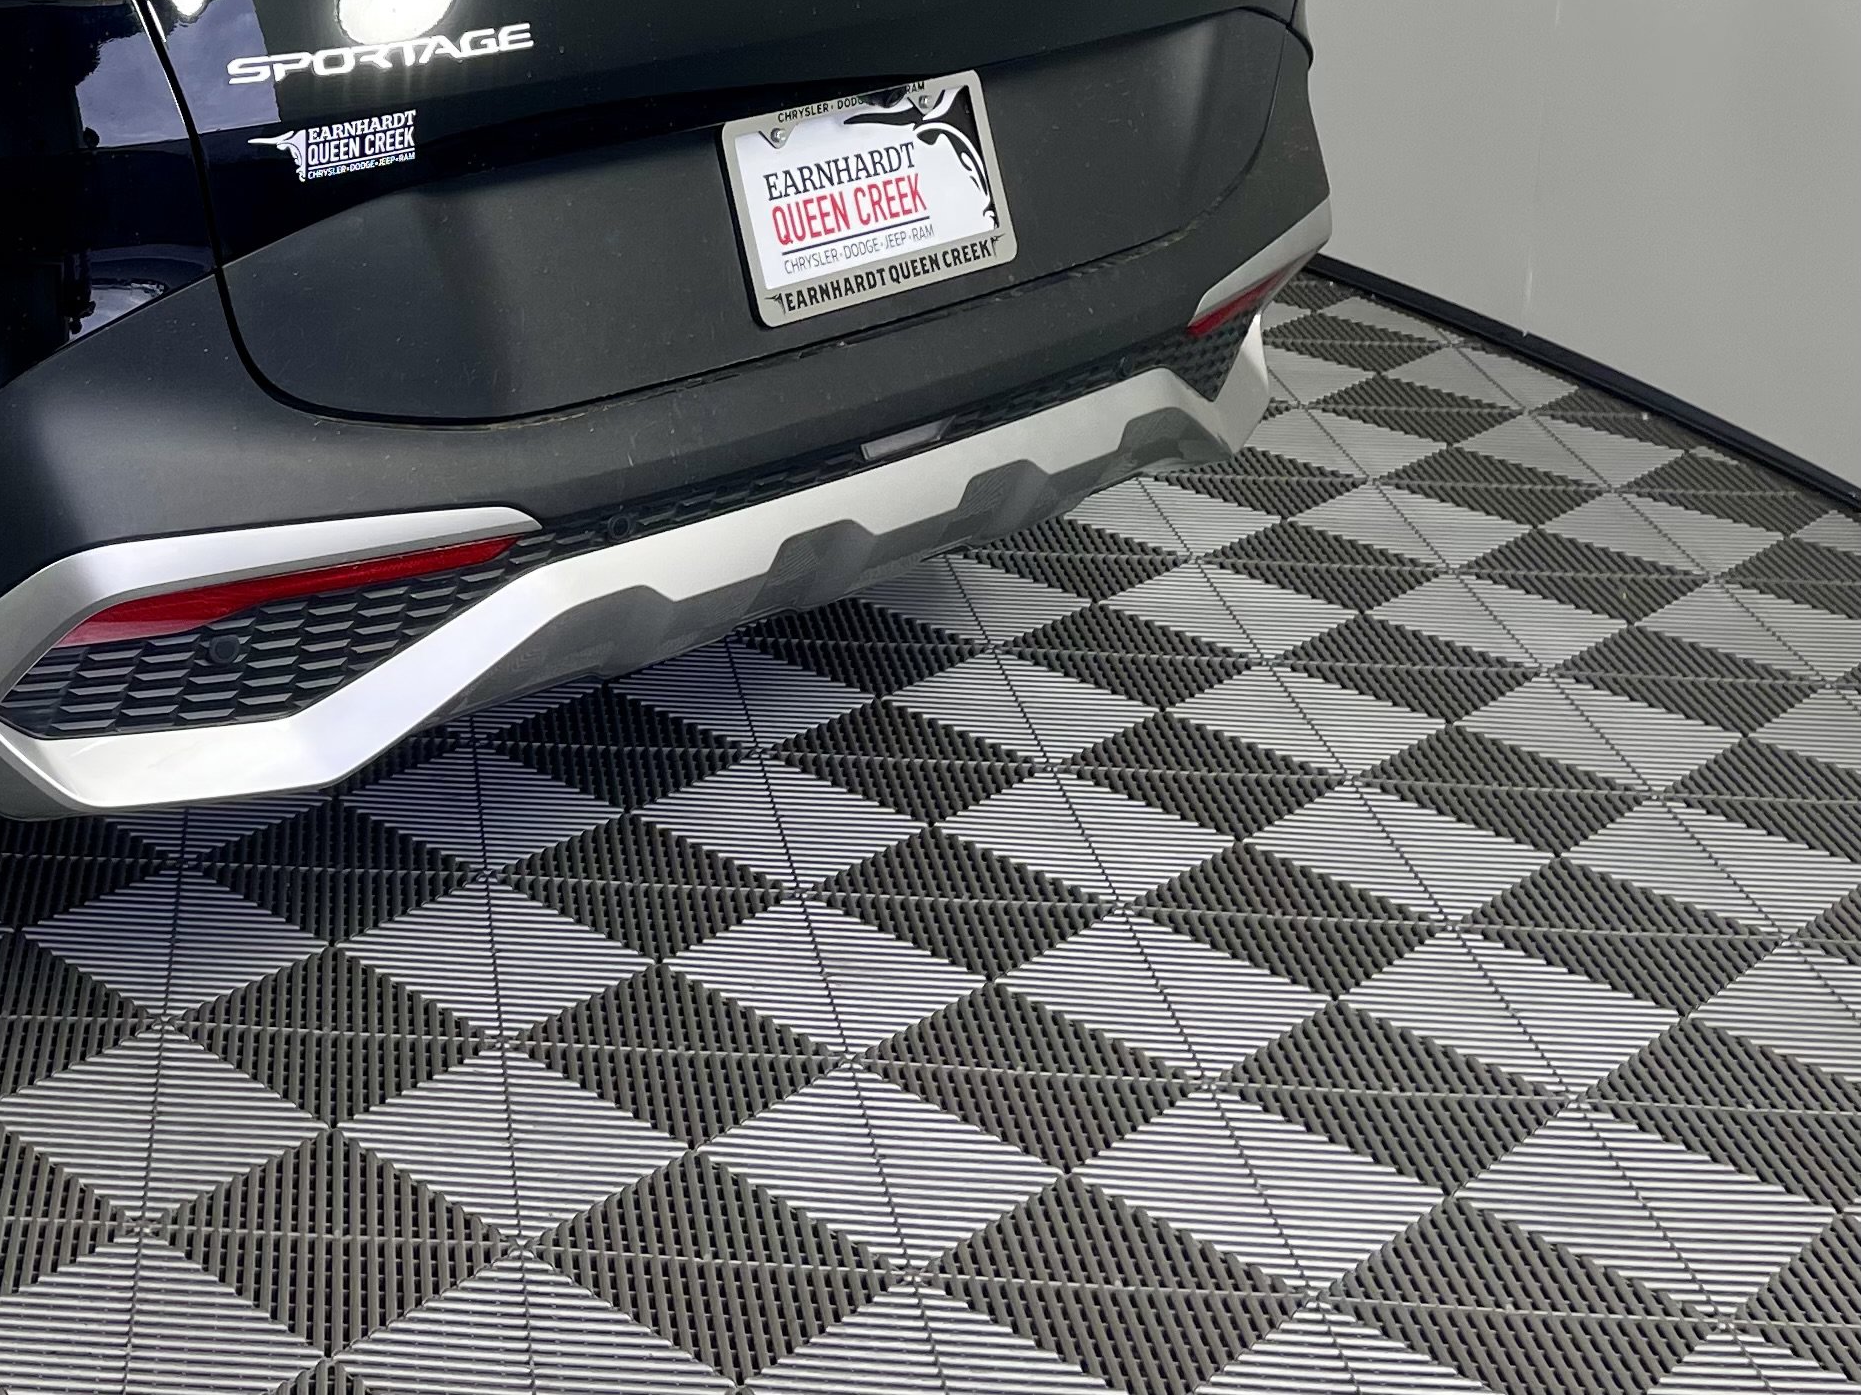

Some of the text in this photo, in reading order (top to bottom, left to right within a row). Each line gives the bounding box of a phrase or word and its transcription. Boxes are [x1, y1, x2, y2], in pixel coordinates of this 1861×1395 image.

[226, 22, 535, 86] SPORTAGE
[307, 109, 417, 144] EARNHARDT
[777, 103, 830, 123] CHRYSLER
[837, 95, 865, 110] DOD
[307, 126, 416, 166] QUEEN CREEK
[762, 141, 915, 202] EARNHARDT
[771, 172, 928, 246] QUEEN CREEK
[785, 239, 993, 312] EARNHARDT QUEEN CREEK
